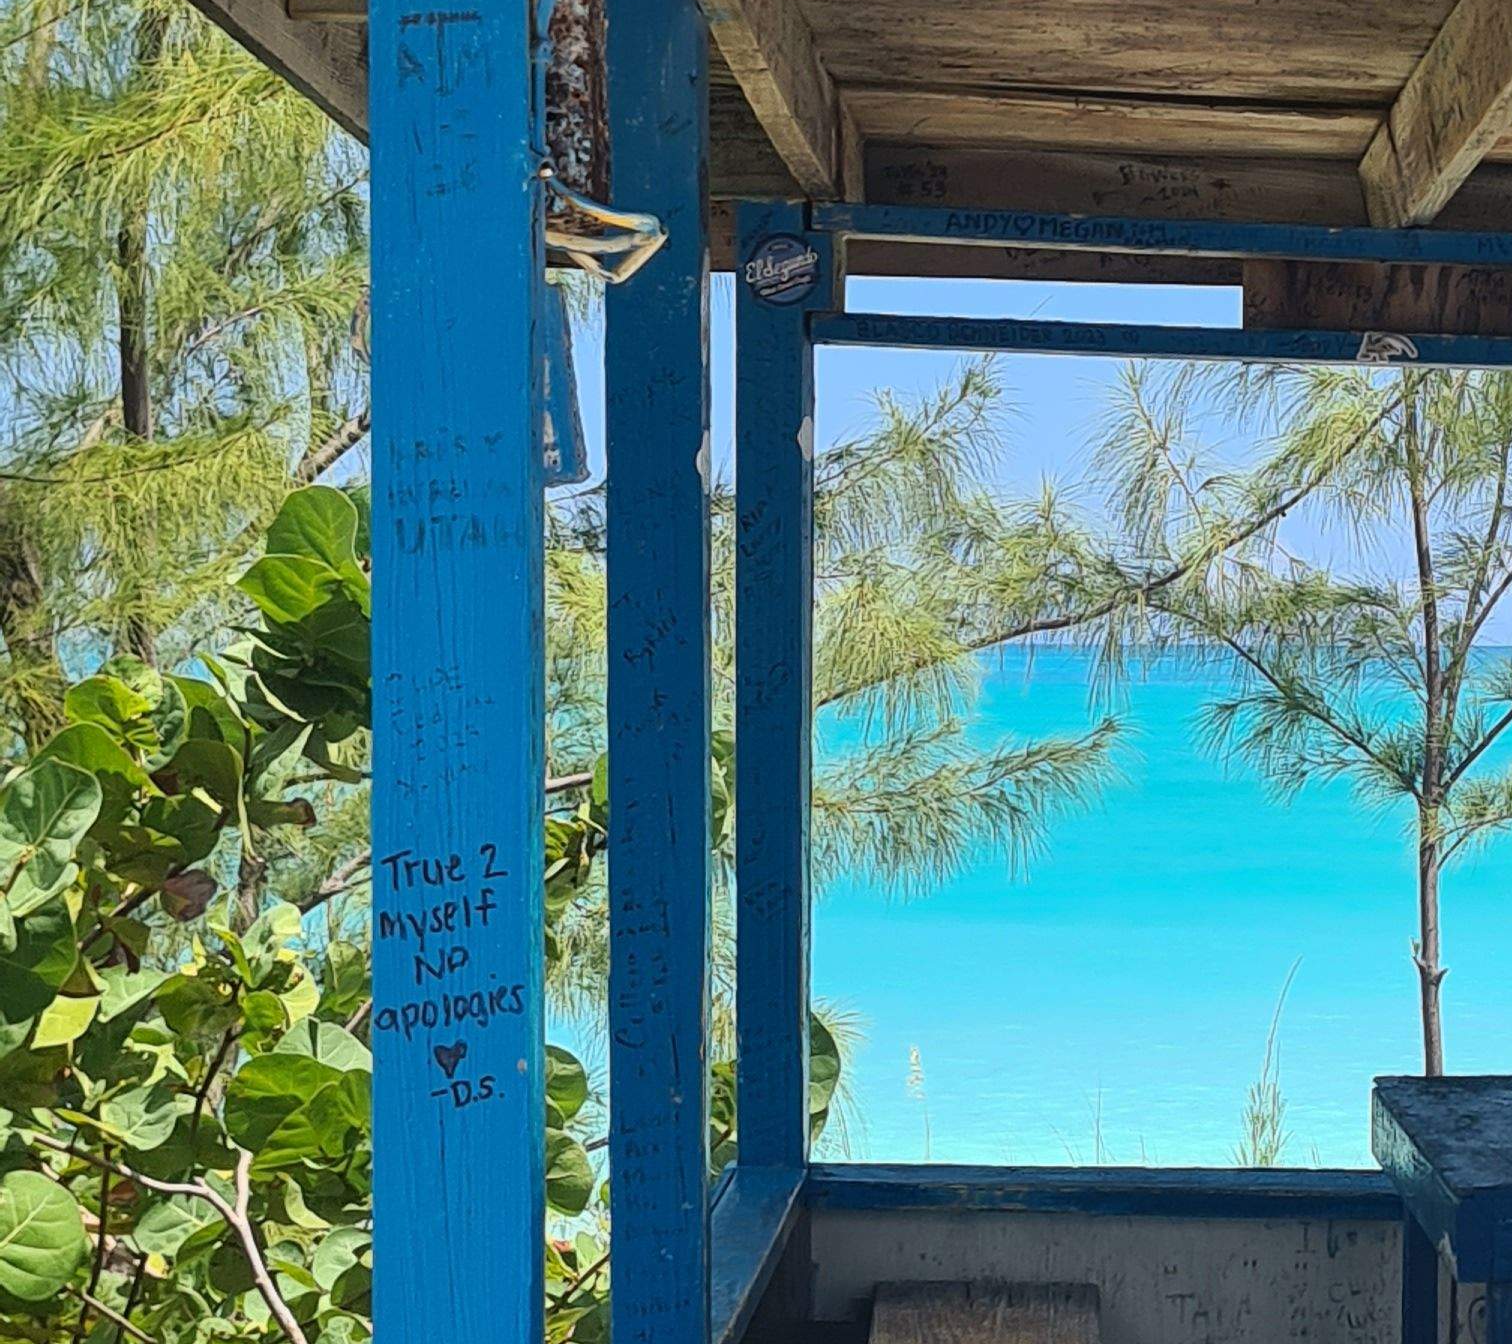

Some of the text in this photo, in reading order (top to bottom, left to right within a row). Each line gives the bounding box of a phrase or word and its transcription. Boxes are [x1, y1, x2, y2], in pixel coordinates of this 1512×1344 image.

[945, 213, 1012, 244] ANDY
[1036, 218, 1124, 249] MEGAN
[381, 843, 508, 891] True 2
[373, 972, 526, 1042] apologies
